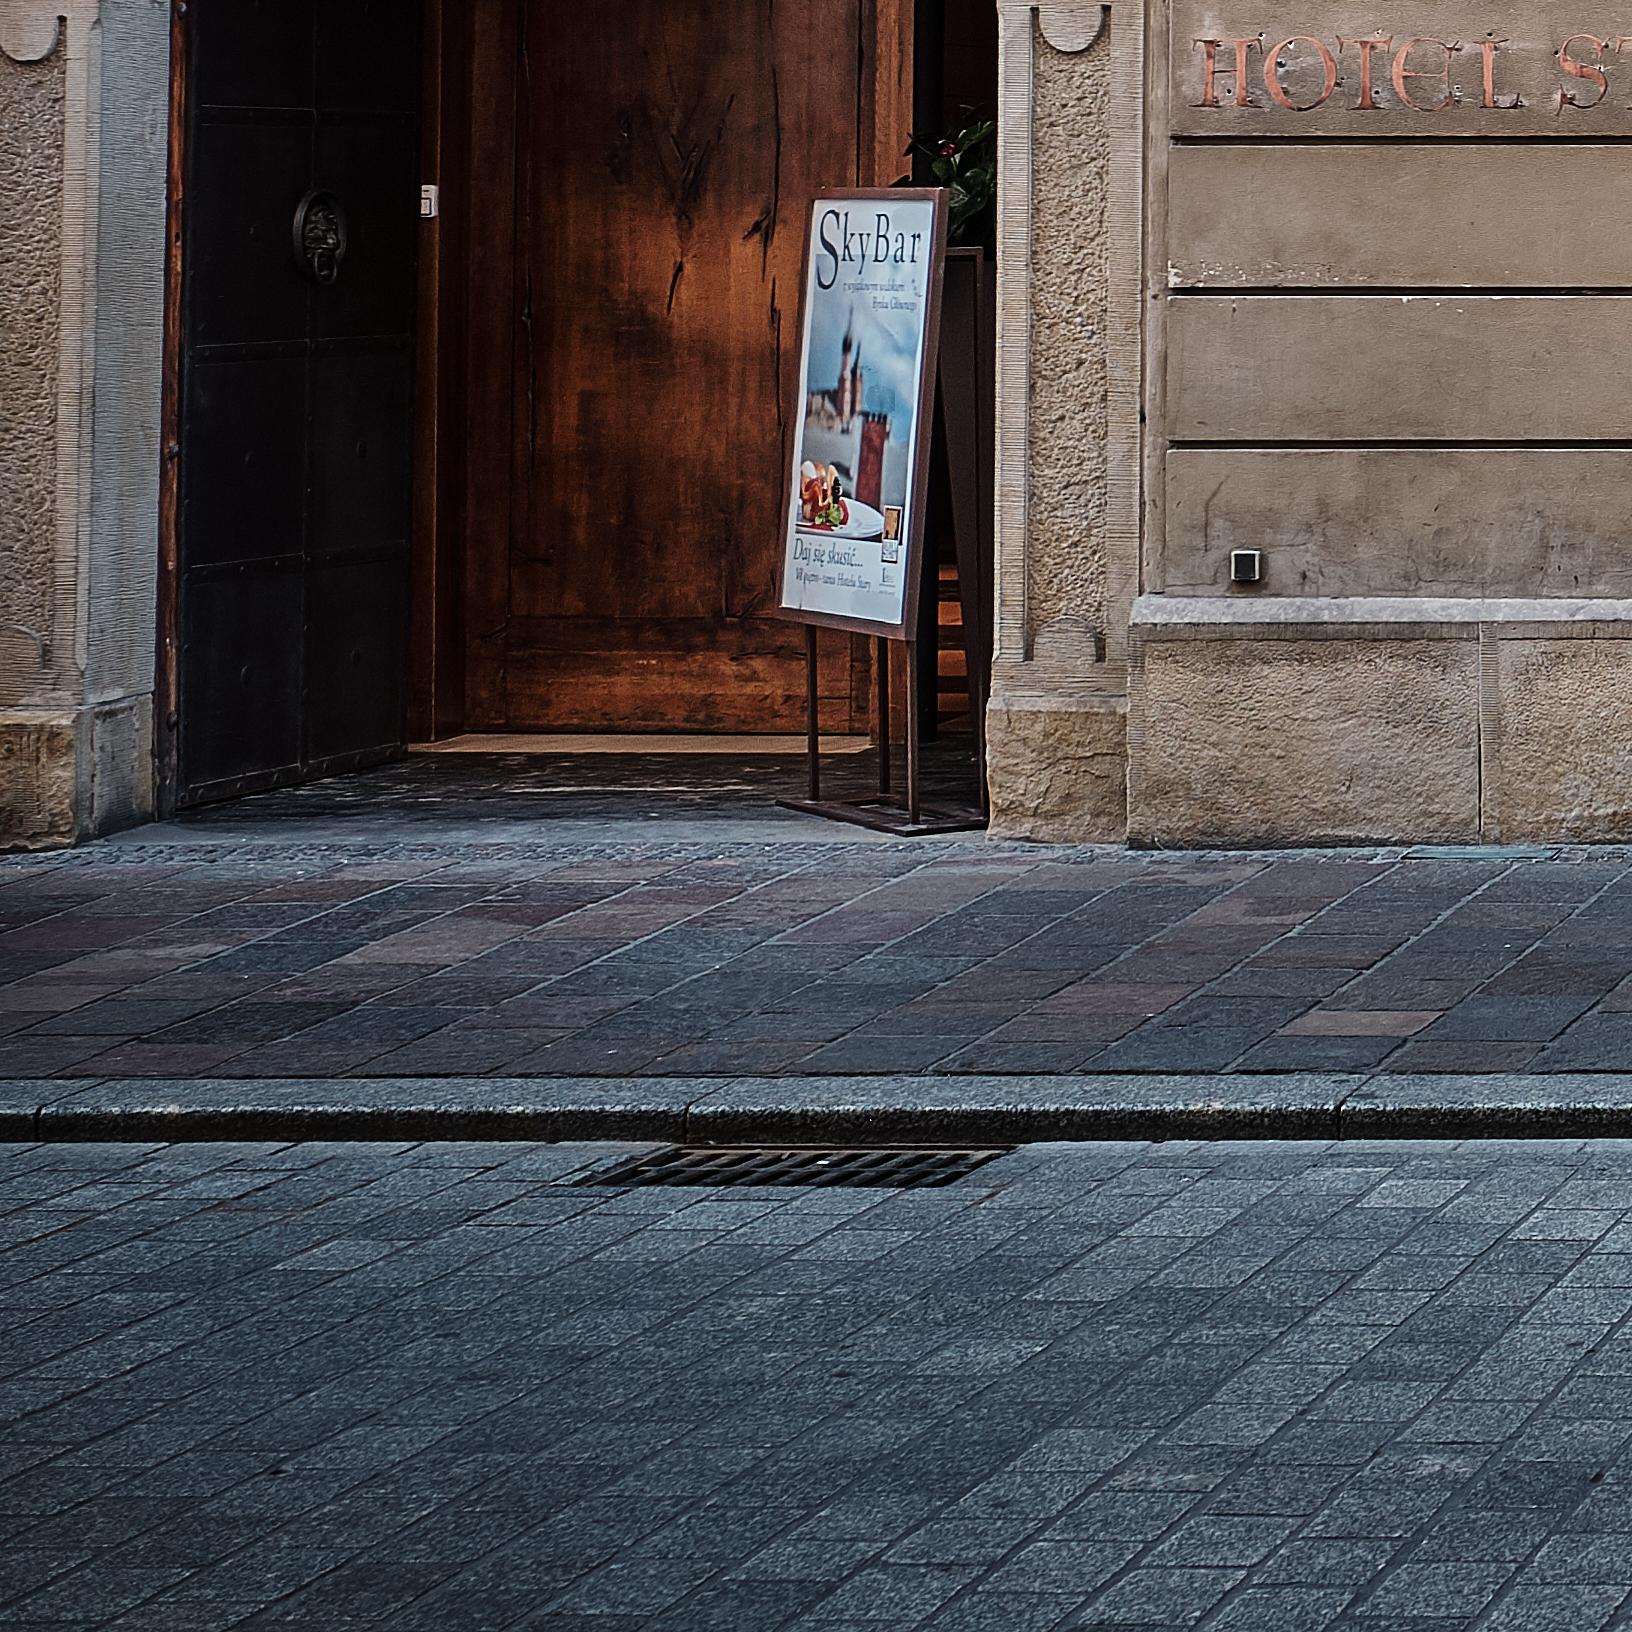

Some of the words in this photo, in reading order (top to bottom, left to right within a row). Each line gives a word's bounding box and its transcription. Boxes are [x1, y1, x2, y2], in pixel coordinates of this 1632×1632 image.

[1190, 34, 1528, 114] HOTEL
[816, 209, 922, 290] SkyBar
[793, 538, 812, 566] Daj
